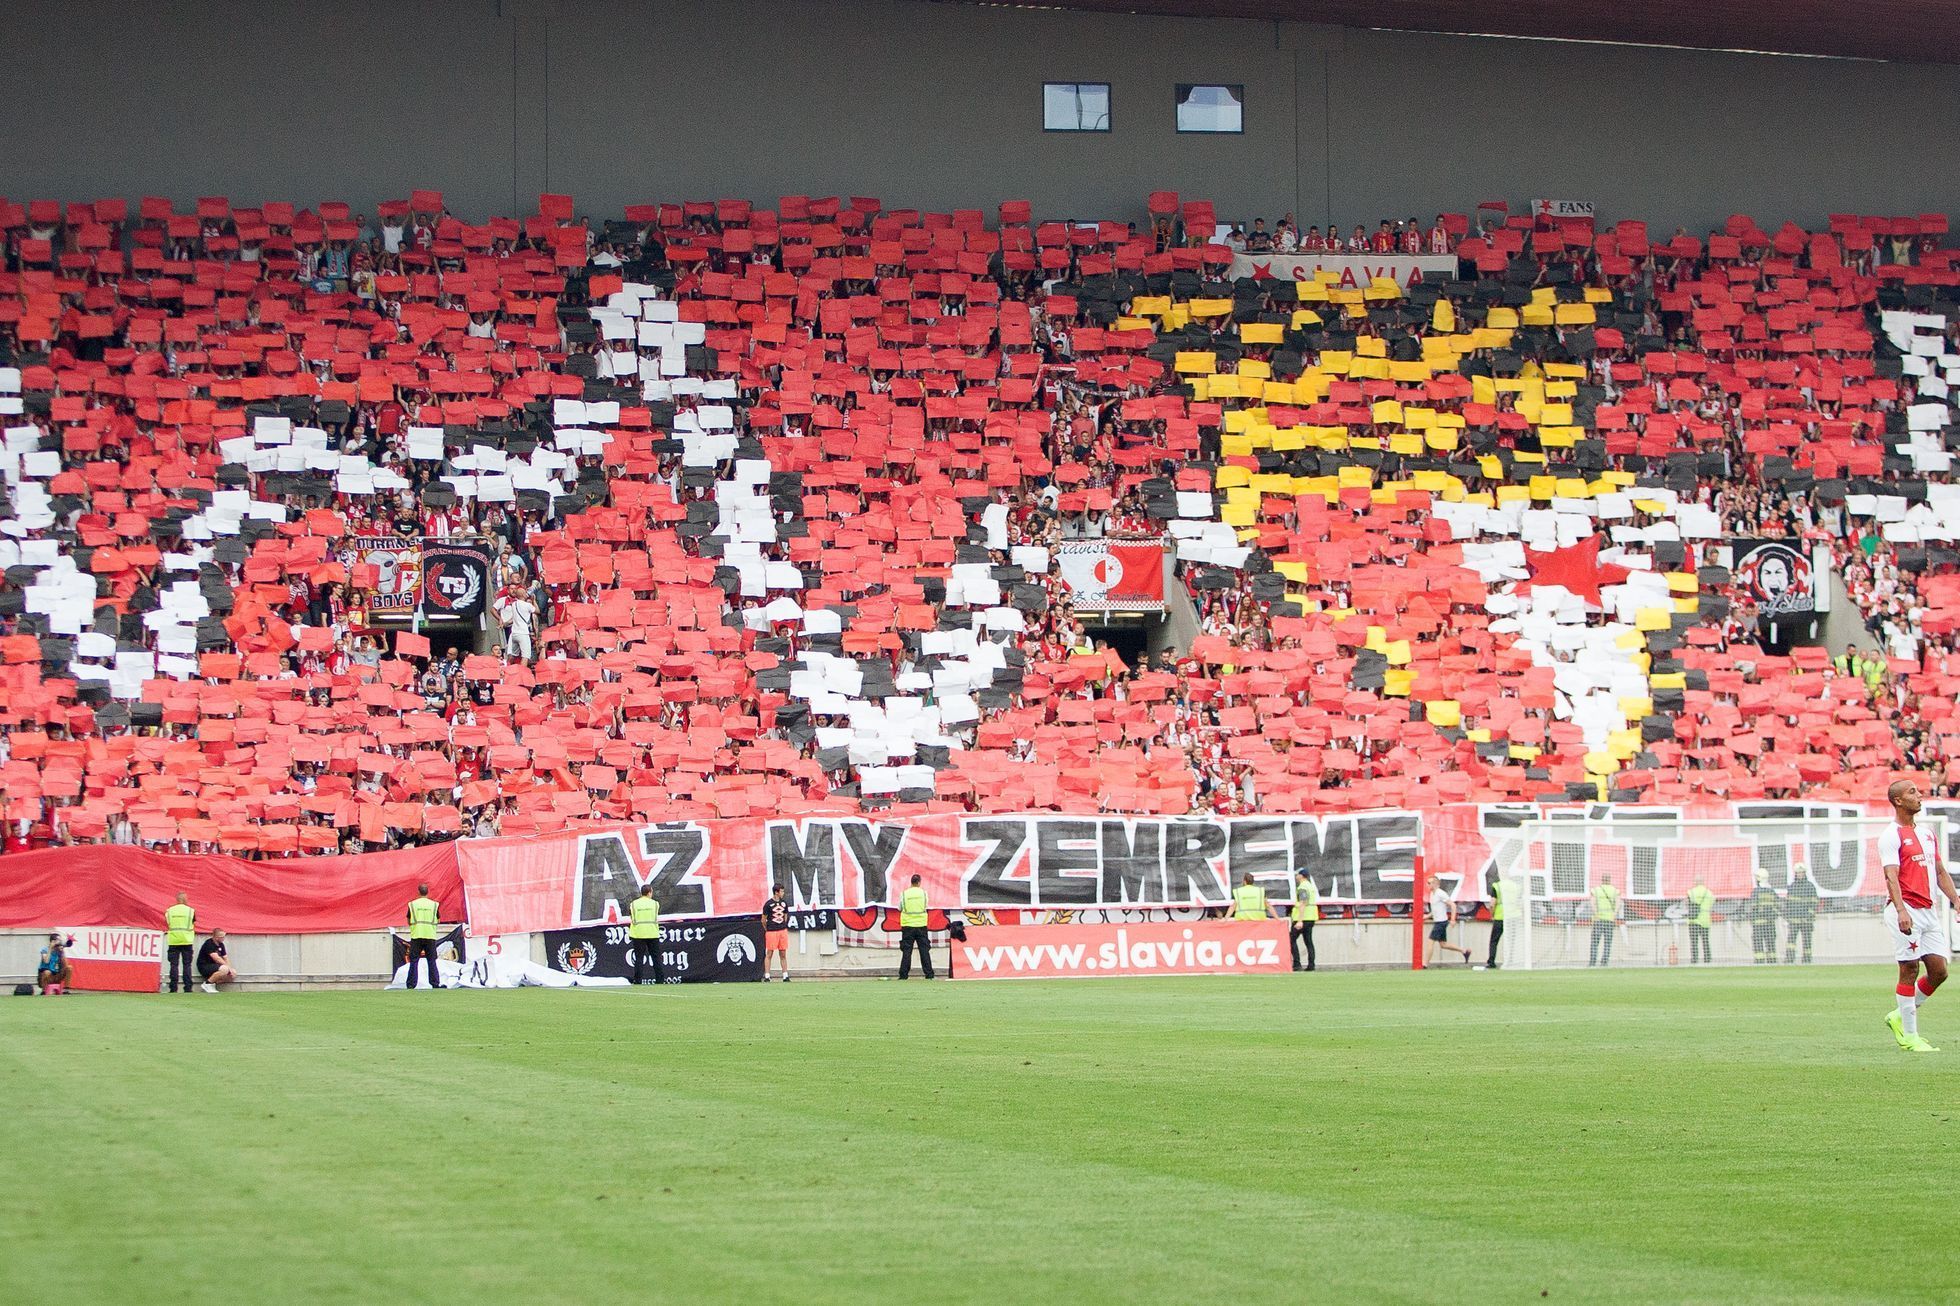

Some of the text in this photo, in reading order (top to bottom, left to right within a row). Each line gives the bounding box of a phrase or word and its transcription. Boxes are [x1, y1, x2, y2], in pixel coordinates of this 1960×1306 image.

[1559, 202, 1594, 213] FANS
[1291, 264, 1424, 290] SAVIA
[373, 592, 413, 608] BOYS
[768, 822, 906, 909] MY
[788, 911, 827, 929] ANS
[87, 931, 161, 958] NIVNICE
[963, 929, 1280, 972] www.slavia.cz
